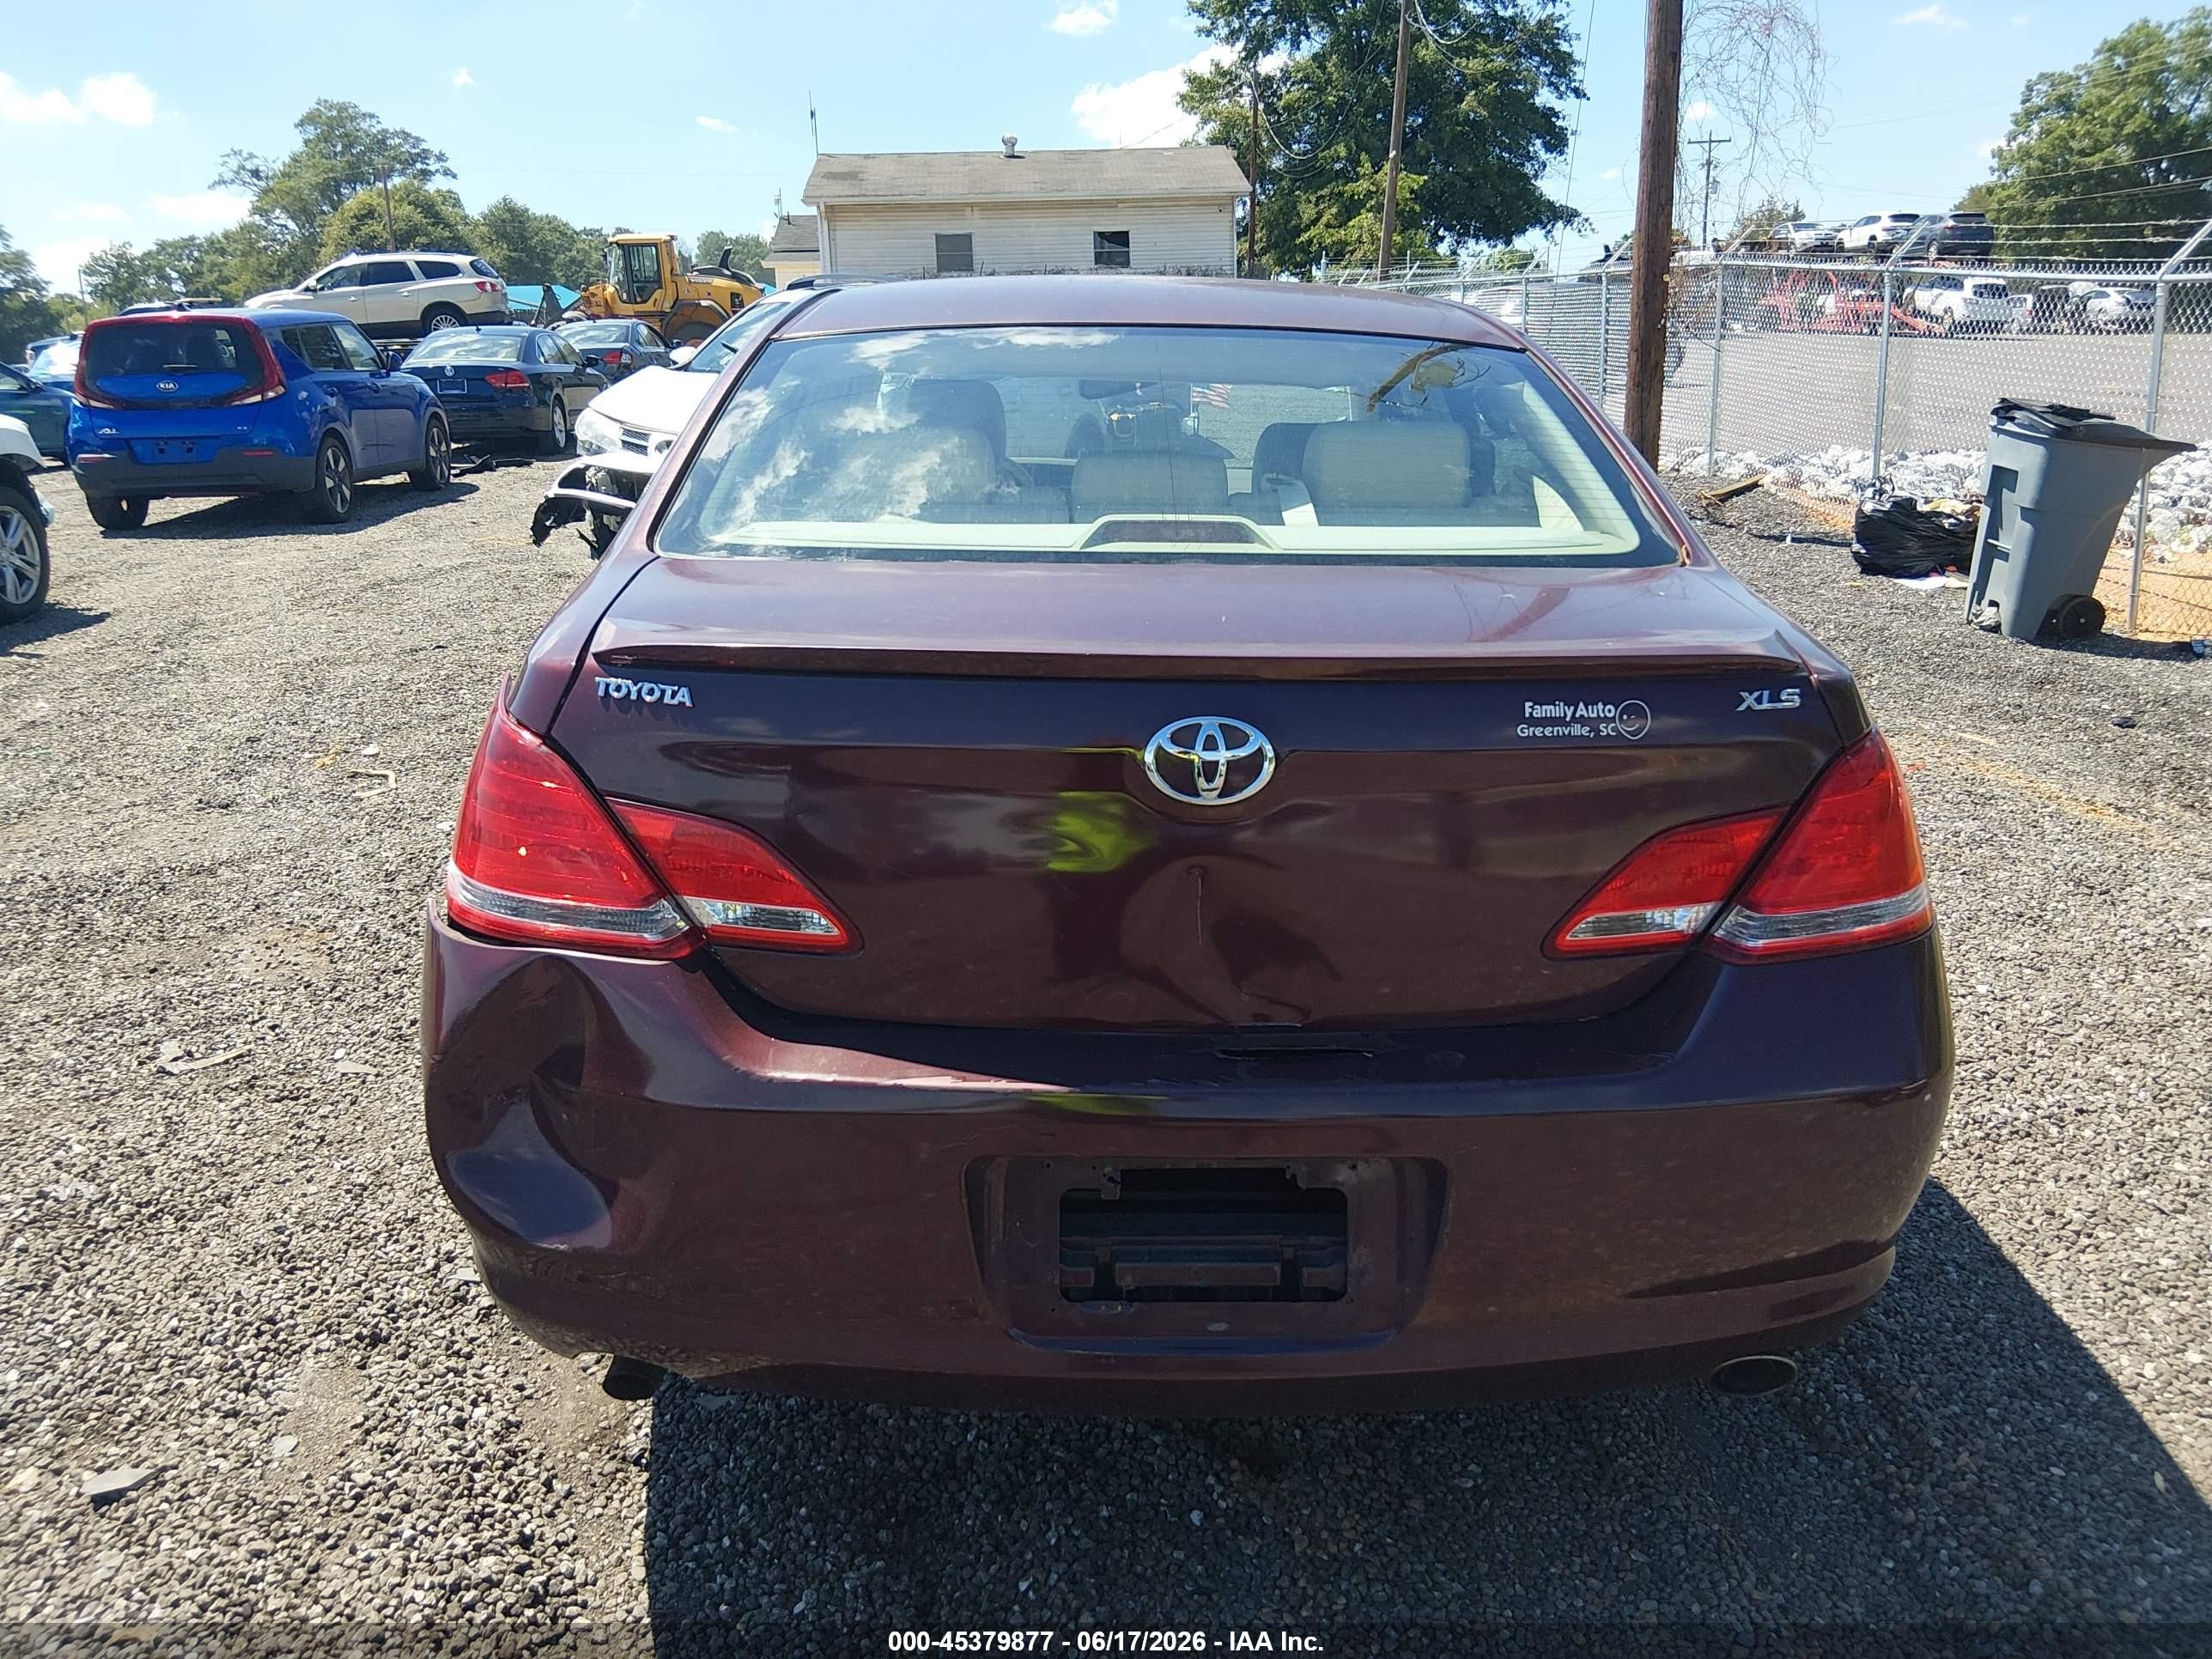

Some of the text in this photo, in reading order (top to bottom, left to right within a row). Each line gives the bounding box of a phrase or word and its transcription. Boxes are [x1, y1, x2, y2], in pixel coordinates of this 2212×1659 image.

[594, 676, 693, 708] TOYOTA
[1735, 689, 1801, 711] XLS
[1523, 701, 1616, 721] Family Auto
[1516, 722, 1617, 738] Greenville, SC
